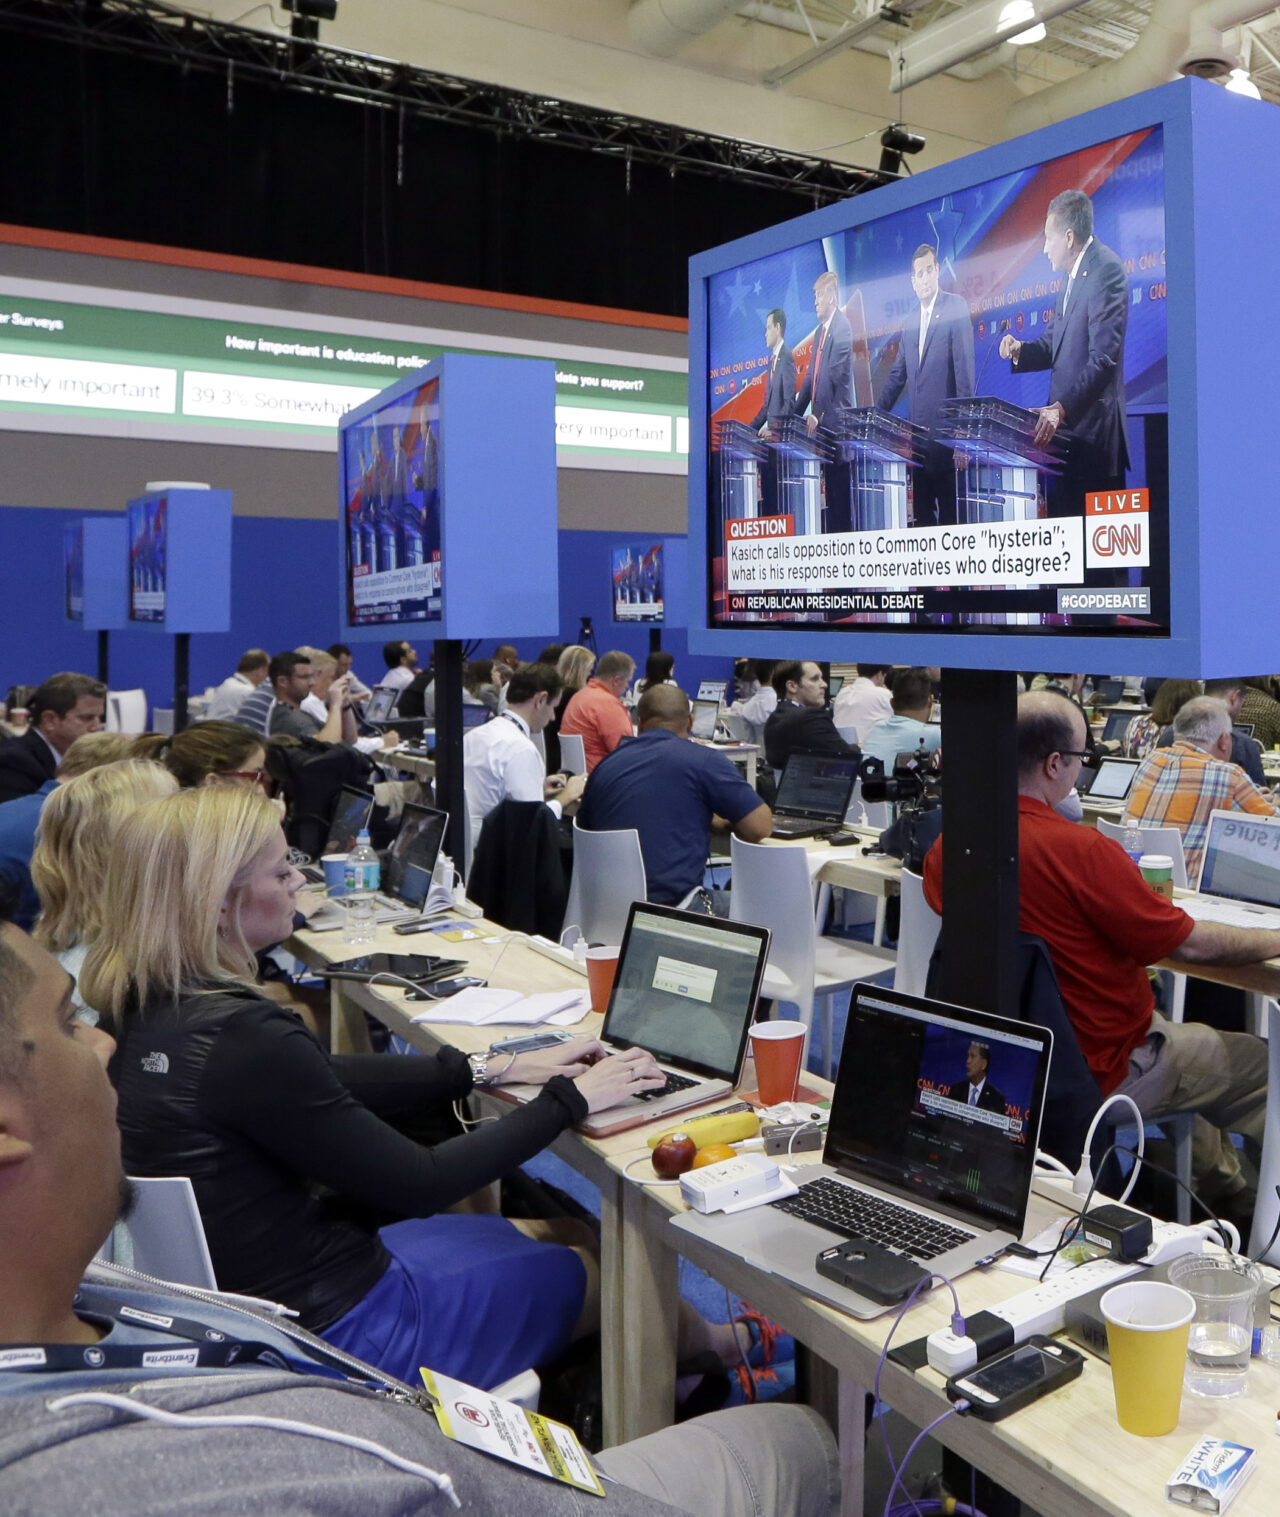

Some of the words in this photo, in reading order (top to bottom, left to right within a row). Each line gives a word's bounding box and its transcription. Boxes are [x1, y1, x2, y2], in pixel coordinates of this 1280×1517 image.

[11, 312, 65, 331] Surveys
[225, 335, 256, 350] How
[258, 338, 320, 358] important
[323, 345, 334, 359] is
[336, 349, 395, 366] education
[58, 377, 161, 399] important
[580, 376, 599, 387] you
[601, 378, 644, 391] support?
[254, 392, 351, 415] Somewhat
[590, 425, 664, 441] important
[1094, 493, 1141, 511] LIVE
[730, 518, 787, 538] QUESTION
[731, 544, 764, 561] Kasich
[767, 542, 790, 559] calls
[793, 539, 855, 559] opposition
[859, 539, 872, 554] to
[876, 536, 936, 554] Common
[941, 532, 976, 551] Core
[981, 526, 1065, 551] "hysteria";
[1092, 523, 1141, 557] CNN
[731, 567, 756, 581] what
[759, 565, 767, 580] is
[770, 564, 785, 580] his
[788, 564, 839, 582] response
[843, 562, 855, 578] to
[859, 557, 951, 578] conservatives
[955, 555, 987, 574] who
[992, 552, 1071, 576] disagree?
[732, 597, 745, 609] CNN
[748, 595, 804, 609] REPUBLICAN
[806, 595, 879, 609] PRESIDENTIAL
[882, 594, 924, 609] DEBATE
[1061, 594, 1147, 609] #GOPDEBATE
[145, 1352, 196, 1365] Eventbrite
[1176, 1440, 1218, 1483] WHITE
[1211, 1448, 1234, 1473] Trident
